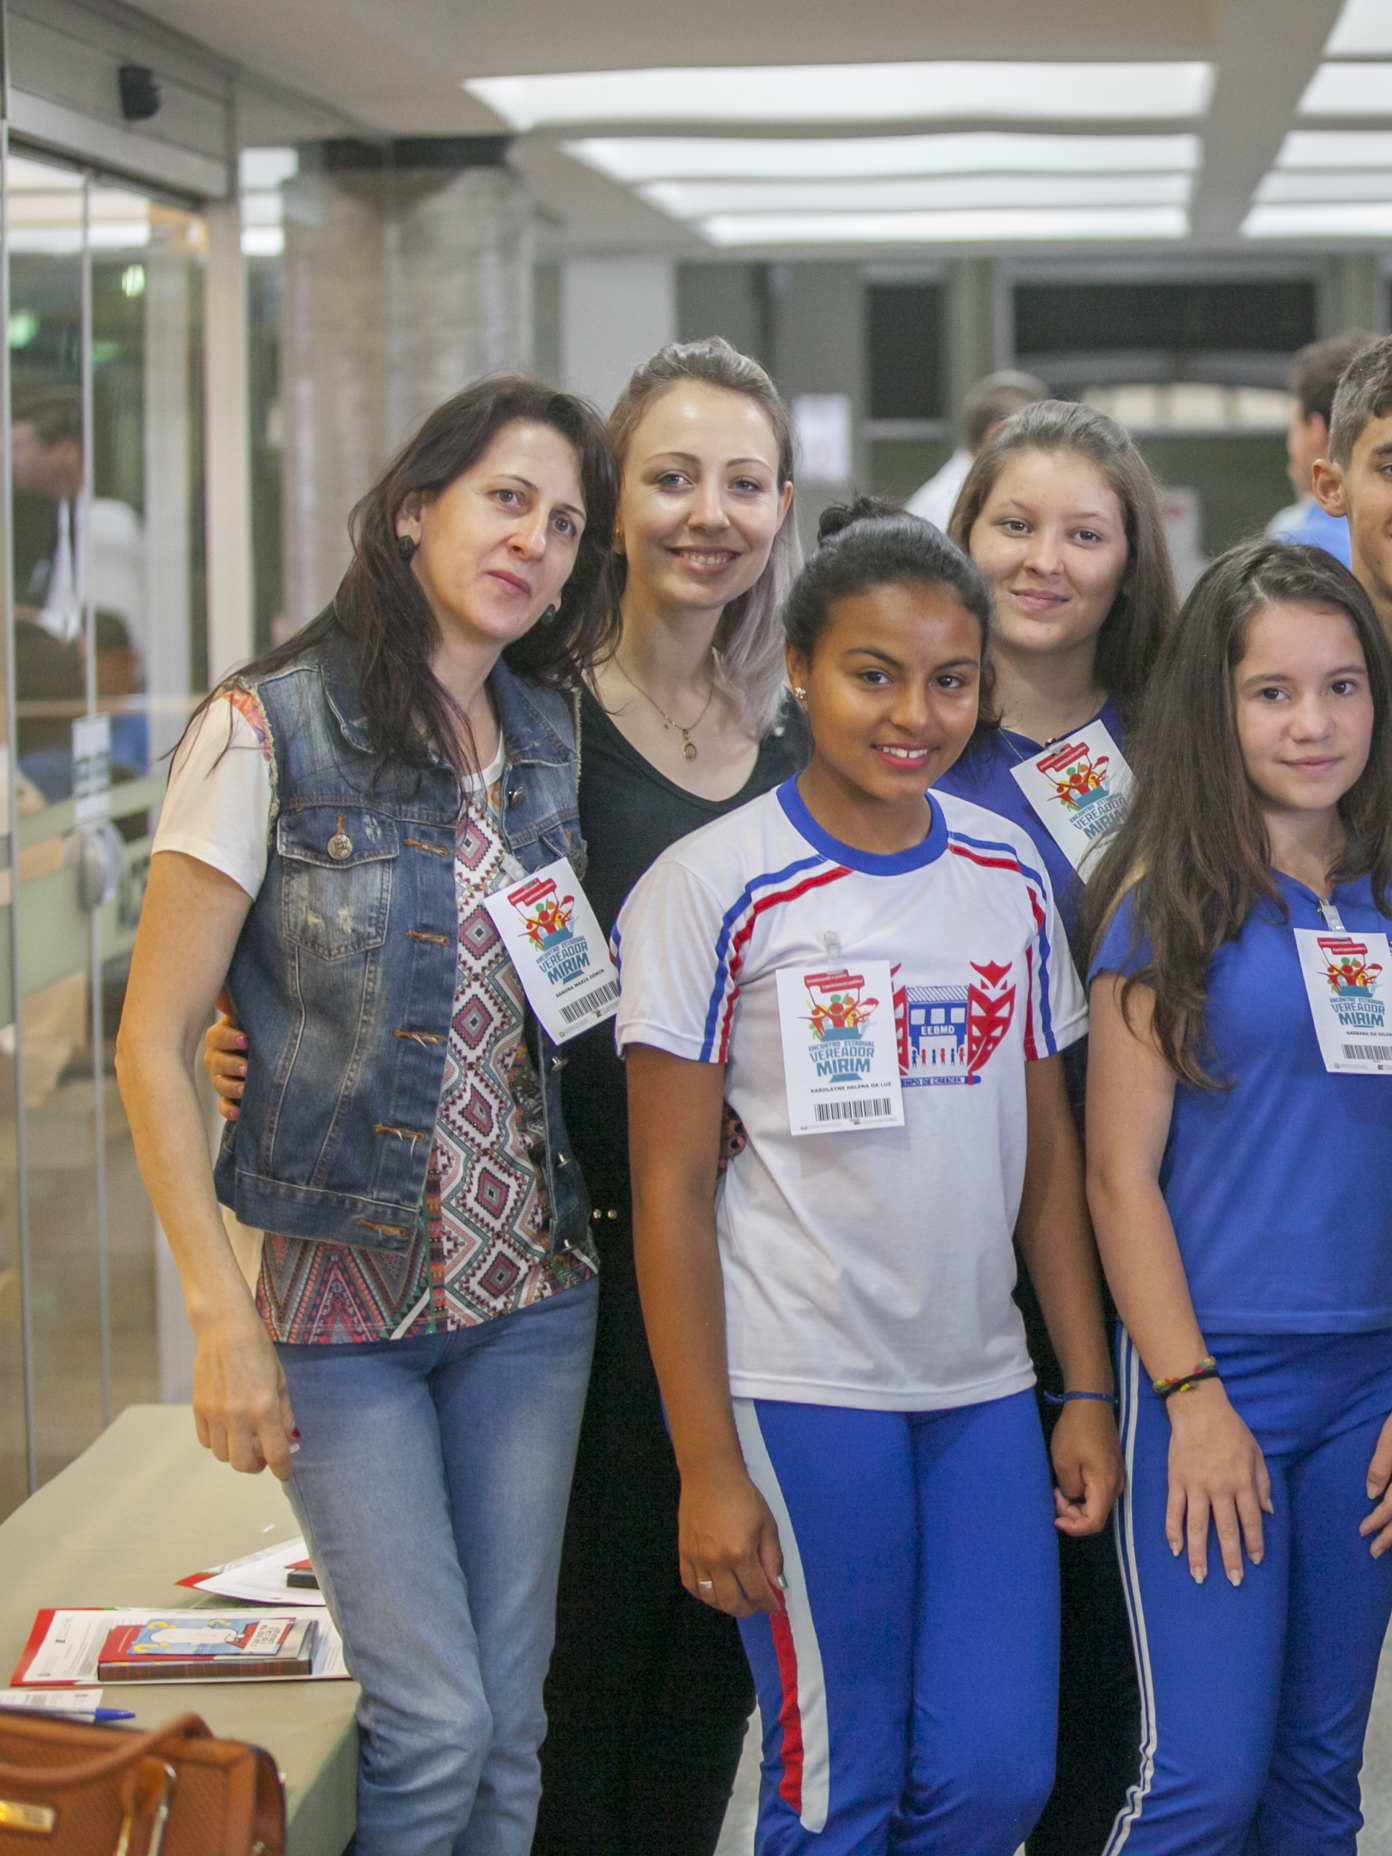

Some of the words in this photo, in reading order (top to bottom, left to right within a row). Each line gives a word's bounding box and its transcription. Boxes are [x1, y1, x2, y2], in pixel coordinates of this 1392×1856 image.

[535, 945, 560, 965] ENCONTRO
[561, 935, 587, 951] ESTADUAL
[538, 941, 589, 973] VEREADOR
[547, 953, 590, 985] MIRIM
[1331, 1003, 1386, 1015] VEREADOR
[1338, 1012, 1385, 1028] MIRIM
[921, 1025, 955, 1036] EEBMD
[808, 1041, 841, 1052] ENCONTRO
[844, 1040, 875, 1048] ESTADUAL
[809, 1046, 875, 1063] VEREADOR
[816, 1058, 871, 1077] MIRIM
